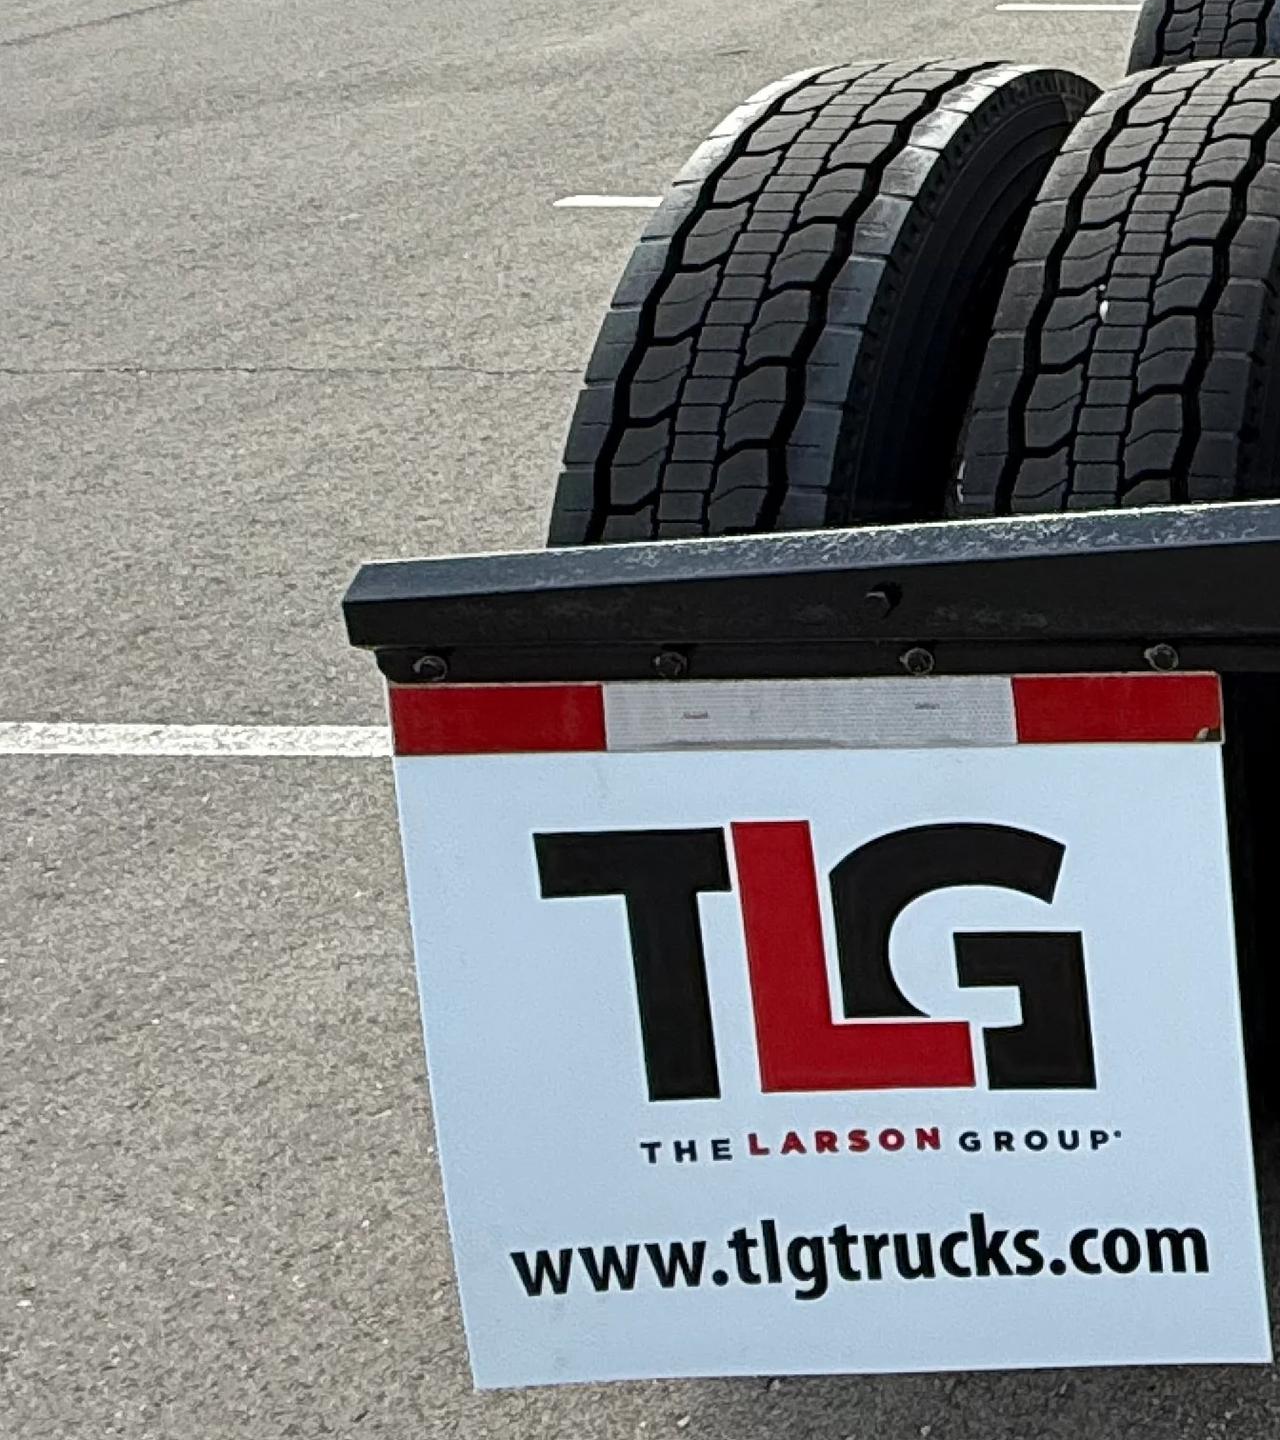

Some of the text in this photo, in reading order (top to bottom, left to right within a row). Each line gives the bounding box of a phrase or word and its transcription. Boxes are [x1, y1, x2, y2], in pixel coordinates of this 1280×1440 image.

[532, 820, 1097, 1103] TLG
[640, 1127, 1111, 1165] THE LARSON GROUP
[510, 1212, 1211, 1302] www.tlgtrucks.com
